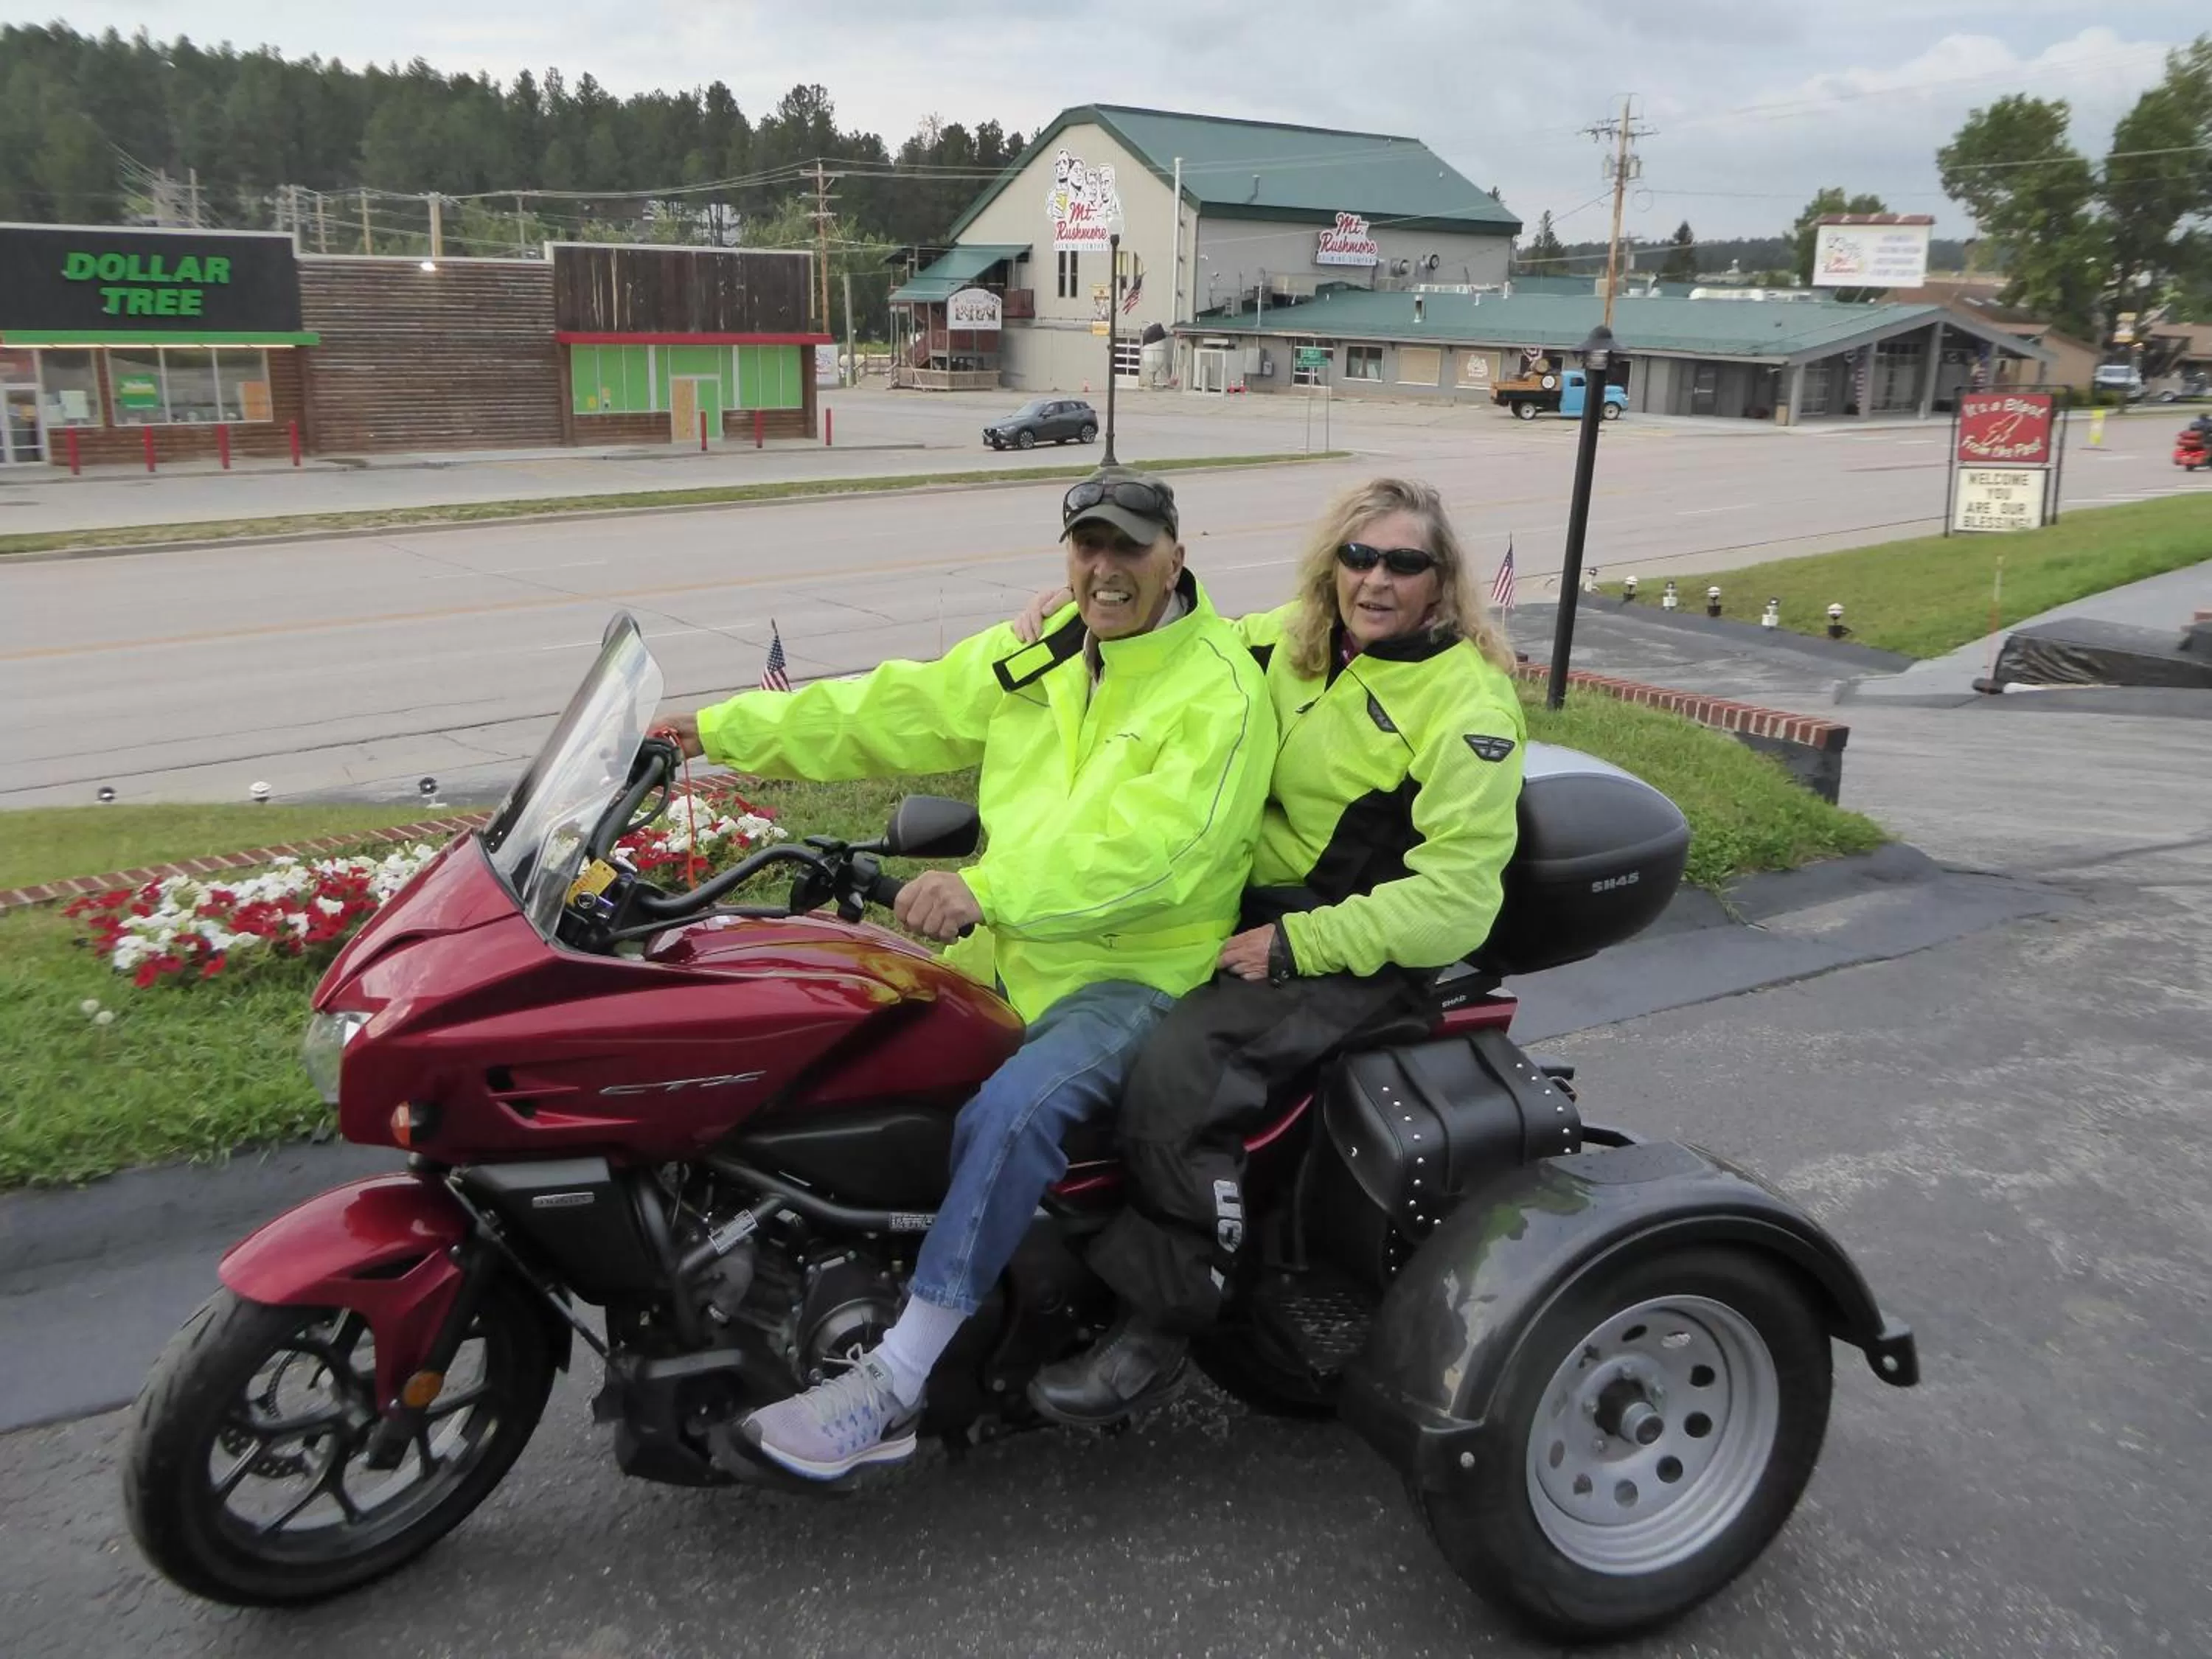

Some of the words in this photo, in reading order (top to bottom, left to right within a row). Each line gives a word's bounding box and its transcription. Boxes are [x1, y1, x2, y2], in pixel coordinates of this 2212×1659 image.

[1069, 201, 1098, 223] Mt.
[1056, 220, 1107, 240] Rushmore
[1337, 214, 1368, 236] Mt.
[1321, 232, 1376, 254] Rushmore
[65, 252, 231, 284] DOLLAR
[99, 287, 203, 316] TREE
[1968, 473, 2029, 486] WELCOME
[1986, 487, 2012, 500] YOU
[1964, 501, 1992, 514] ARE
[2000, 502, 2025, 515] OUR
[1592, 872, 1640, 893] SH45
